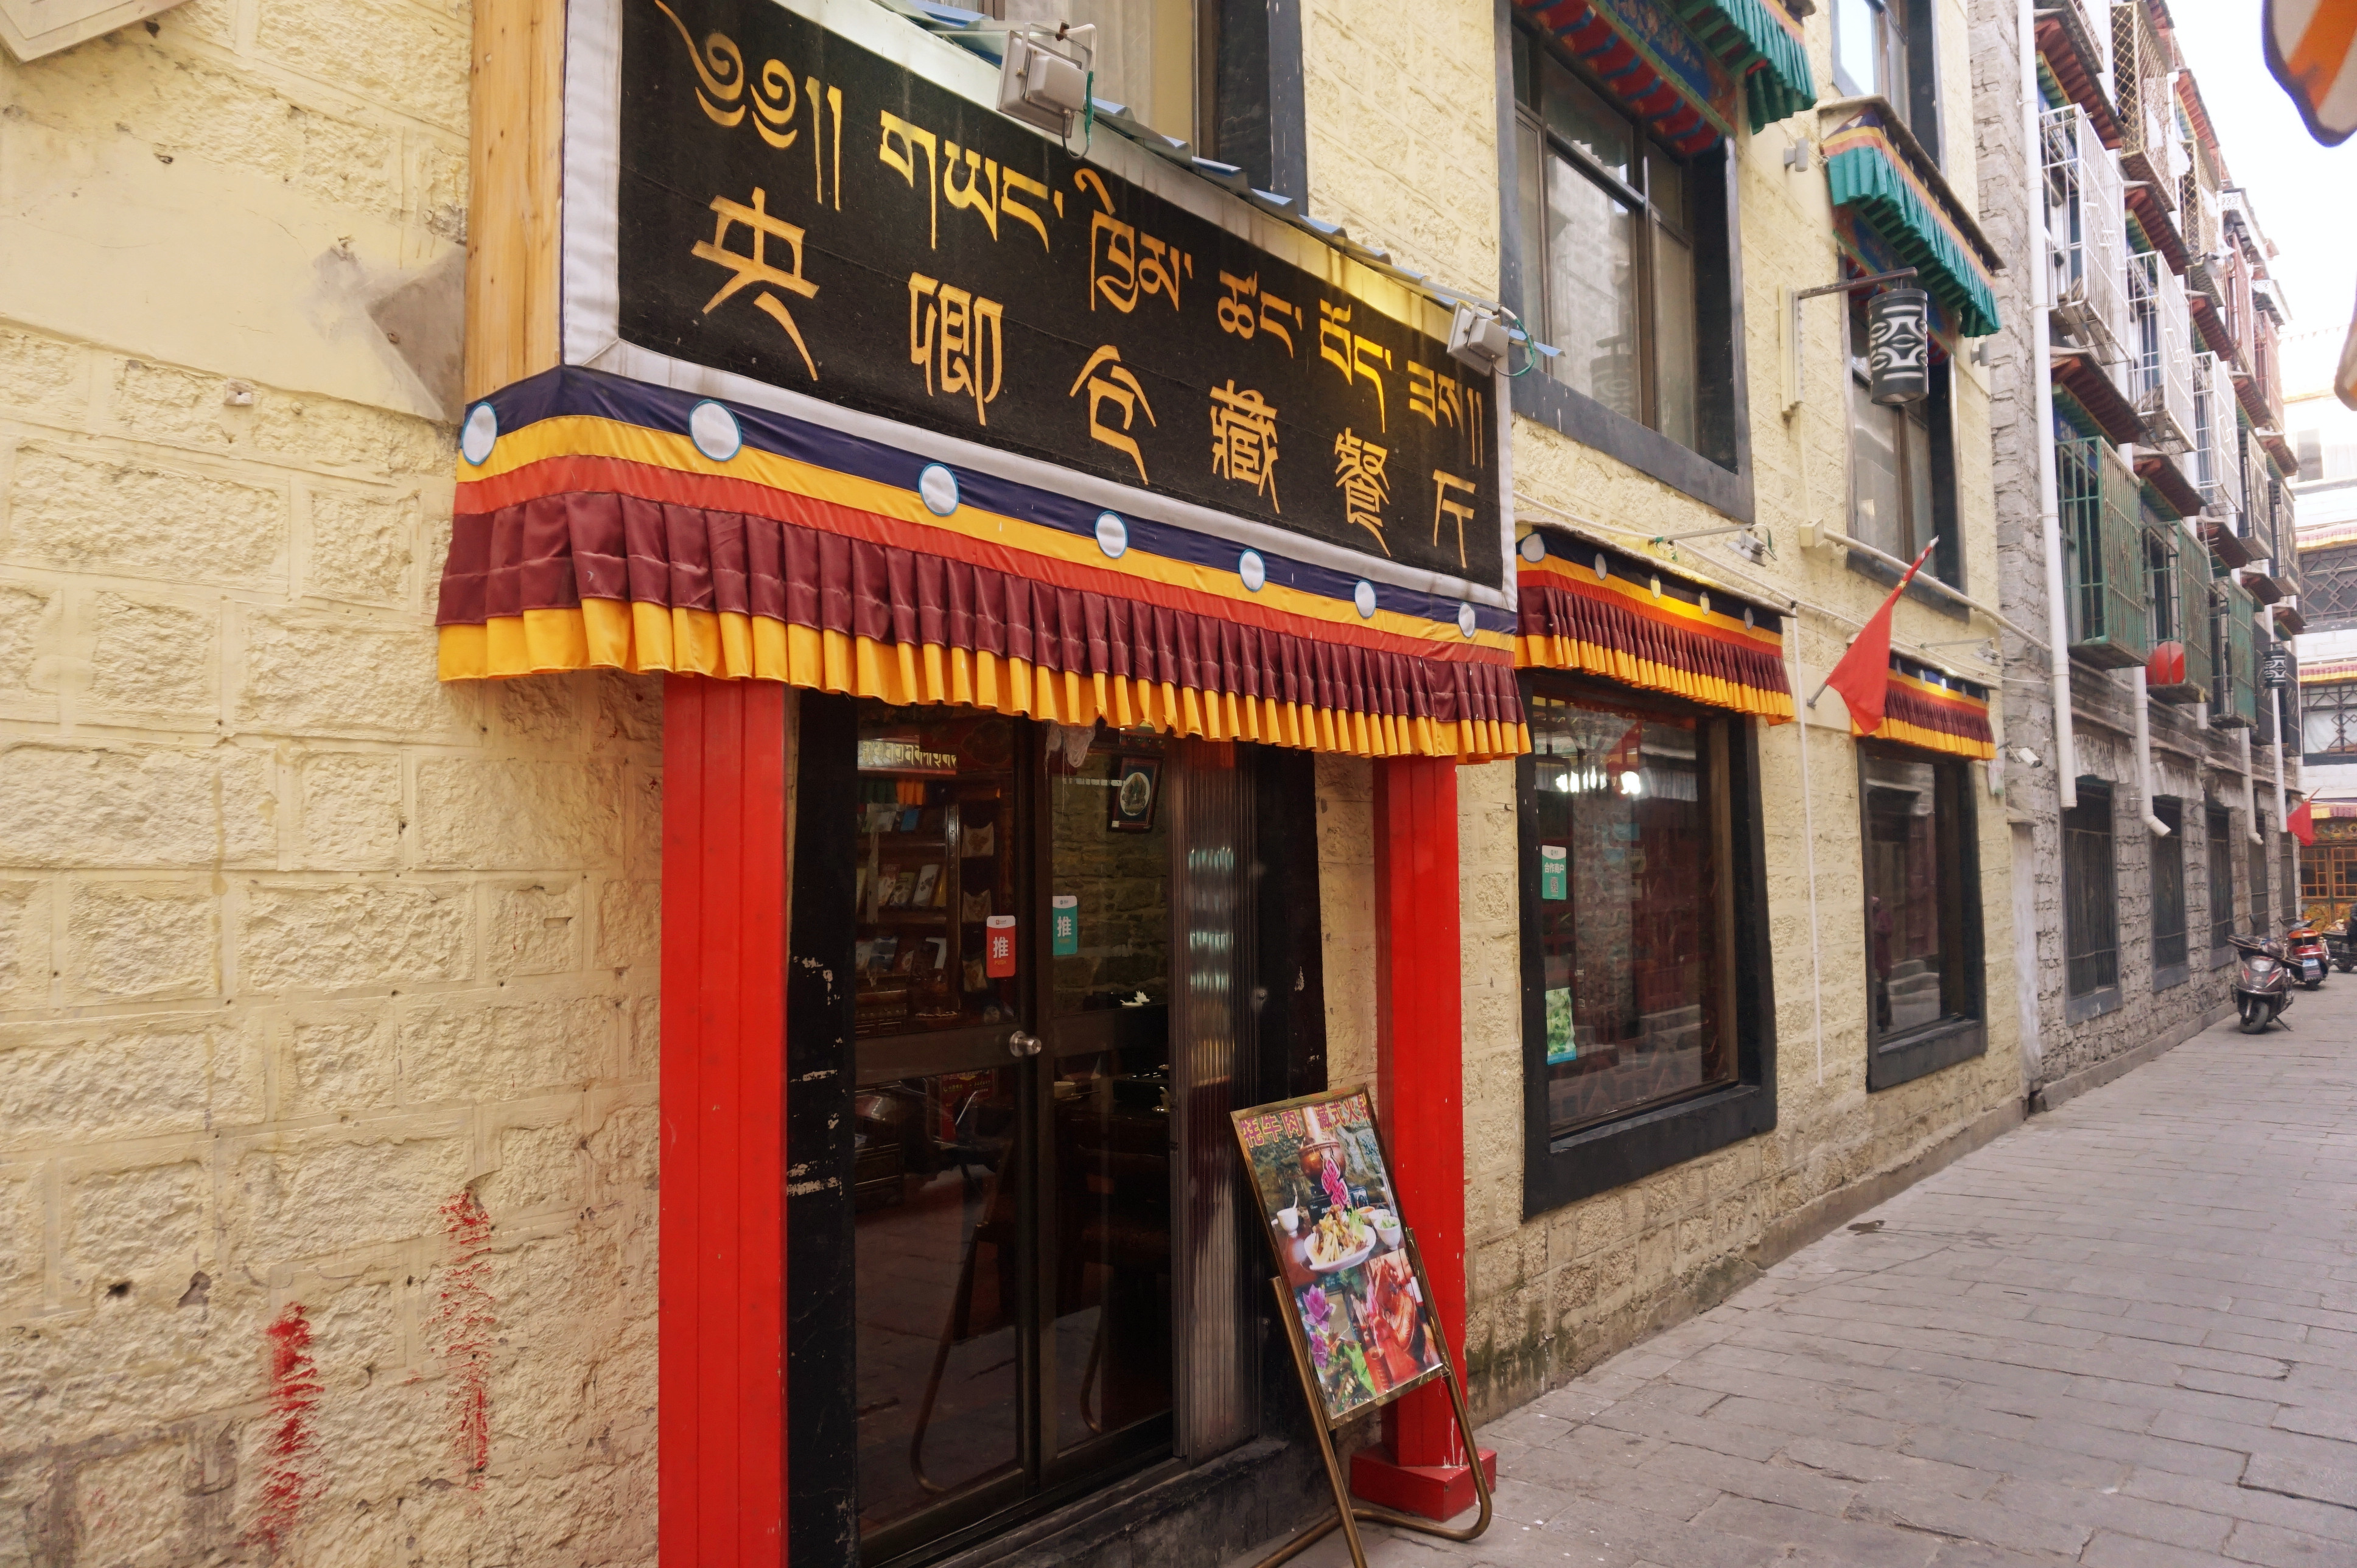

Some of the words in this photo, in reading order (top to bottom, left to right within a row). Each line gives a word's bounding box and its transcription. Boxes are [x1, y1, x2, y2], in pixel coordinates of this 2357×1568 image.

[691, 186, 1476, 569] 央卿仓藏餐厅
[1057, 915, 1072, 937] 推
[993, 936, 1009, 959] 推
